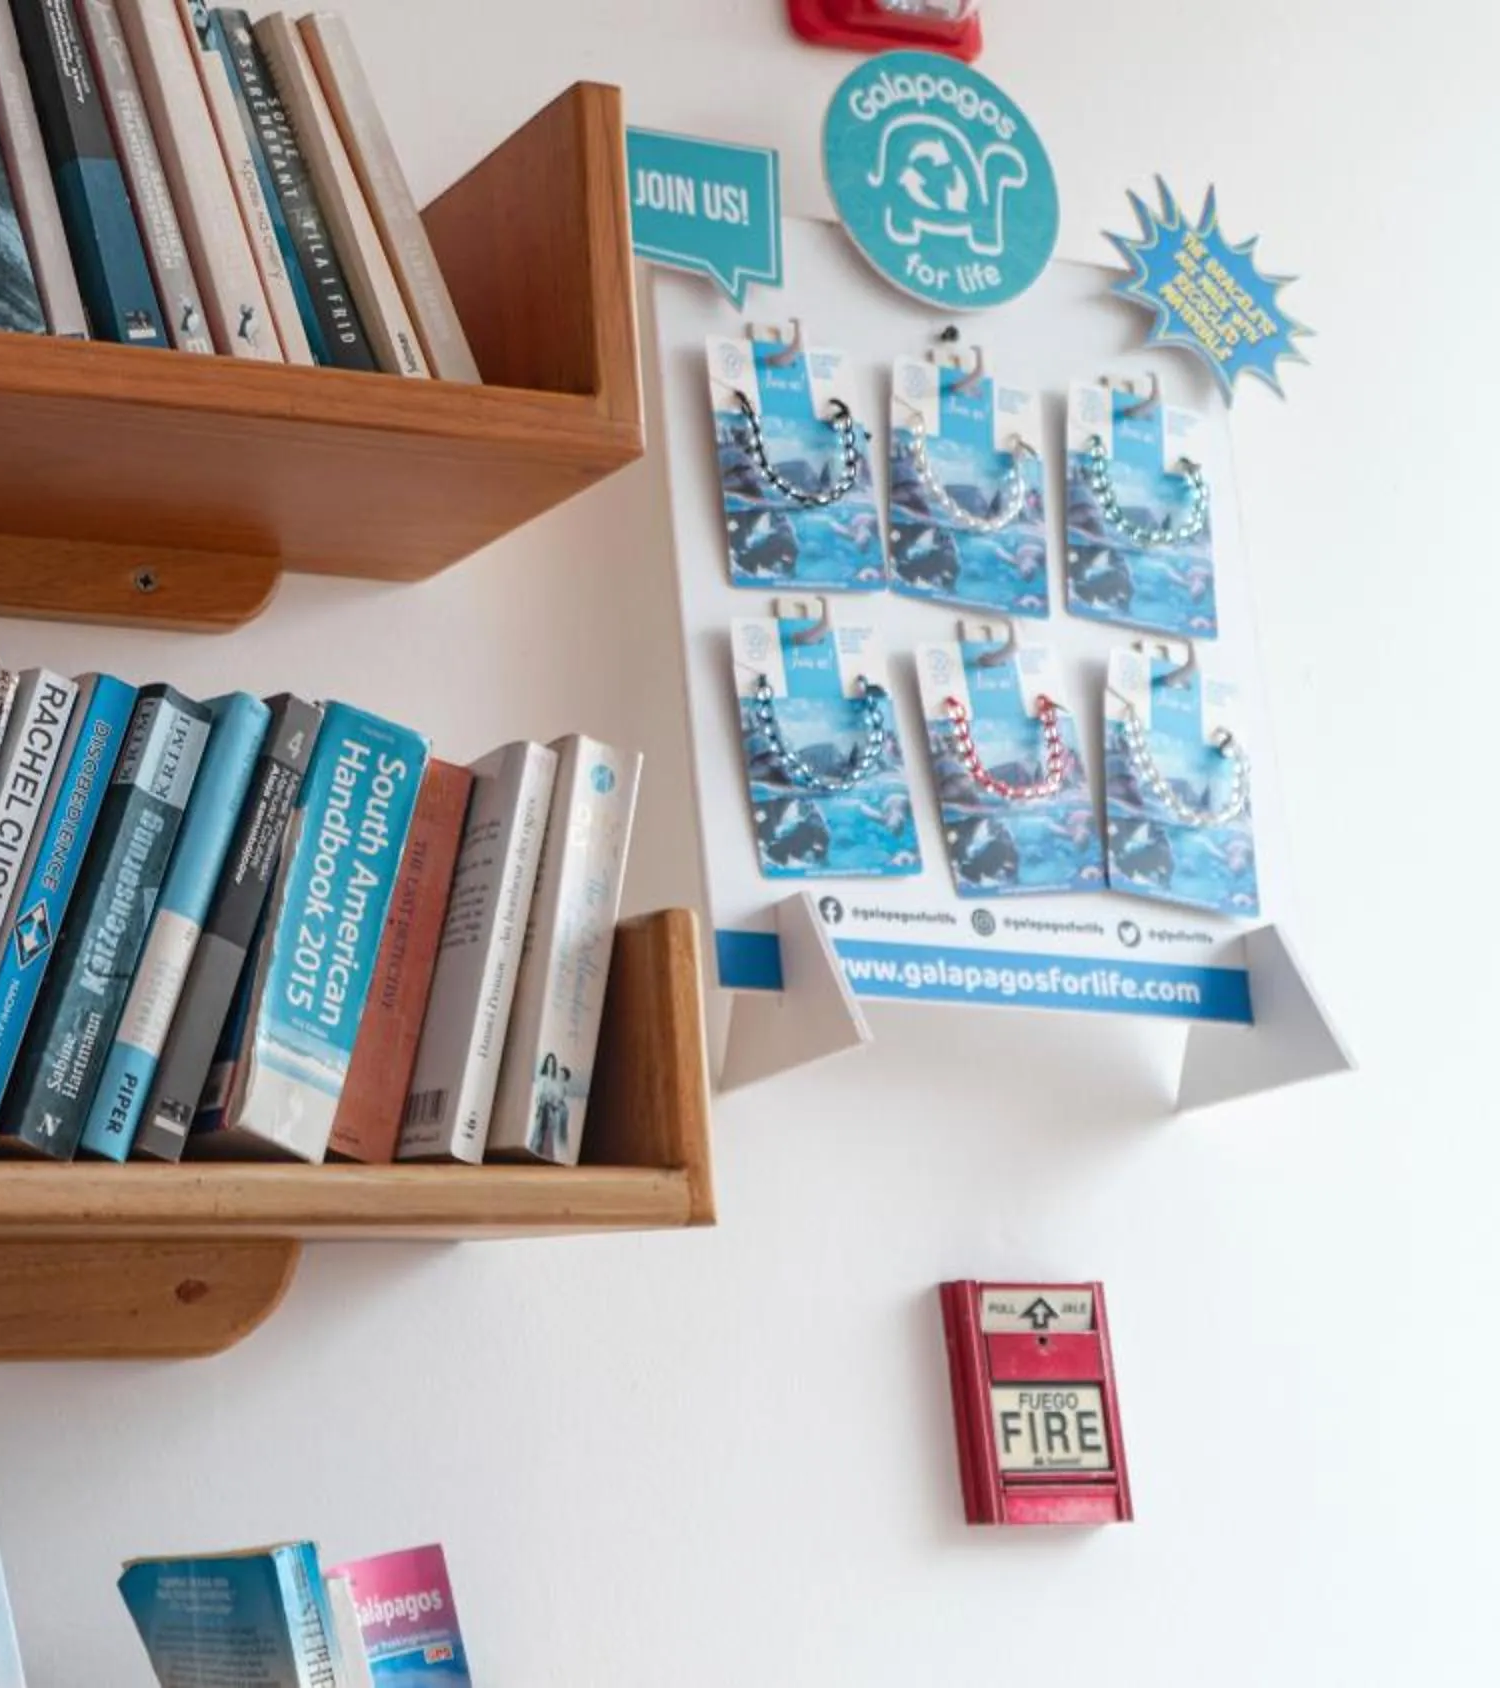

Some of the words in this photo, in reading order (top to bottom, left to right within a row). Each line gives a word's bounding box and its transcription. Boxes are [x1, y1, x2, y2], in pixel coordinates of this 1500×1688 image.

[237, 56, 300, 201] SARENBRANT
[267, 97, 299, 159] SOFIE
[849, 72, 1016, 142] Galapagos
[635, 168, 697, 217] JOIN
[703, 184, 749, 226] US!
[300, 218, 328, 270] VILA
[326, 292, 357, 345] FRID
[906, 254, 952, 289] for
[957, 261, 1001, 296] life
[1173, 272, 1239, 345] RECYCLED
[1174, 252, 1197, 276] ARE
[1198, 276, 1232, 311] MADE
[1232, 312, 1260, 344] WITH
[1183, 231, 1210, 258] THE
[1205, 258, 1277, 336] BRACELETS
[1159, 281, 1232, 361] MATERIALS
[5, 682, 68, 811] RACHEL
[156, 716, 191, 799] KRIMI
[42, 721, 113, 893] DISOBEDIENCE
[303, 738, 371, 921] Handbook
[356, 753, 407, 855] South
[79, 810, 164, 997] Katzensprung
[318, 858, 380, 1026] American
[851, 904, 957, 927] @galapagosforlife
[1003, 916, 1105, 937] @galapagosforlife
[286, 925, 327, 1012] 2015
[47, 1033, 78, 1092] Sabine
[61, 1012, 101, 1100] Hartmann
[108, 1073, 138, 1135] PIPER
[988, 1303, 1018, 1315] PULL
[1060, 1303, 1087, 1315] JALE
[1000, 1410, 1103, 1455] FIRE
[1018, 1391, 1079, 1410] FUEGO
